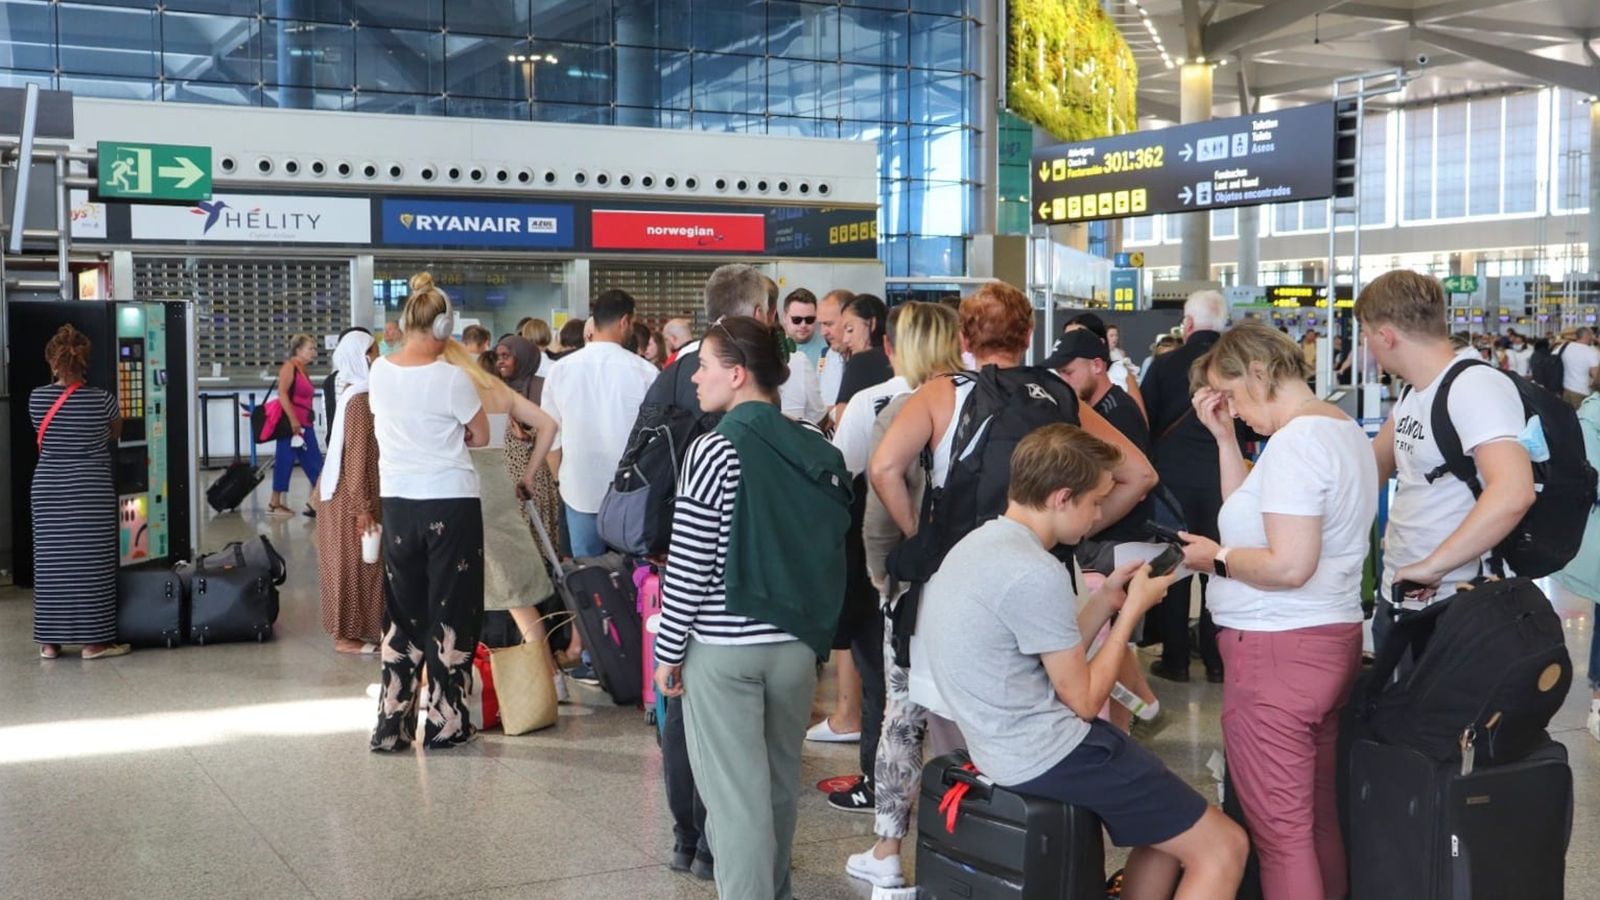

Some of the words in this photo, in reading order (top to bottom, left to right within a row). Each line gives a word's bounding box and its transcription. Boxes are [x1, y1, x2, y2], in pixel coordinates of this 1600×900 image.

[1252, 143, 1275, 154] Aseos
[1214, 190, 1242, 204] Objetos
[1243, 185, 1292, 200] encontrados
[226, 207, 321, 230] HÉLITY
[415, 214, 521, 233] RYANAIR
[646, 224, 714, 239] norwegian
